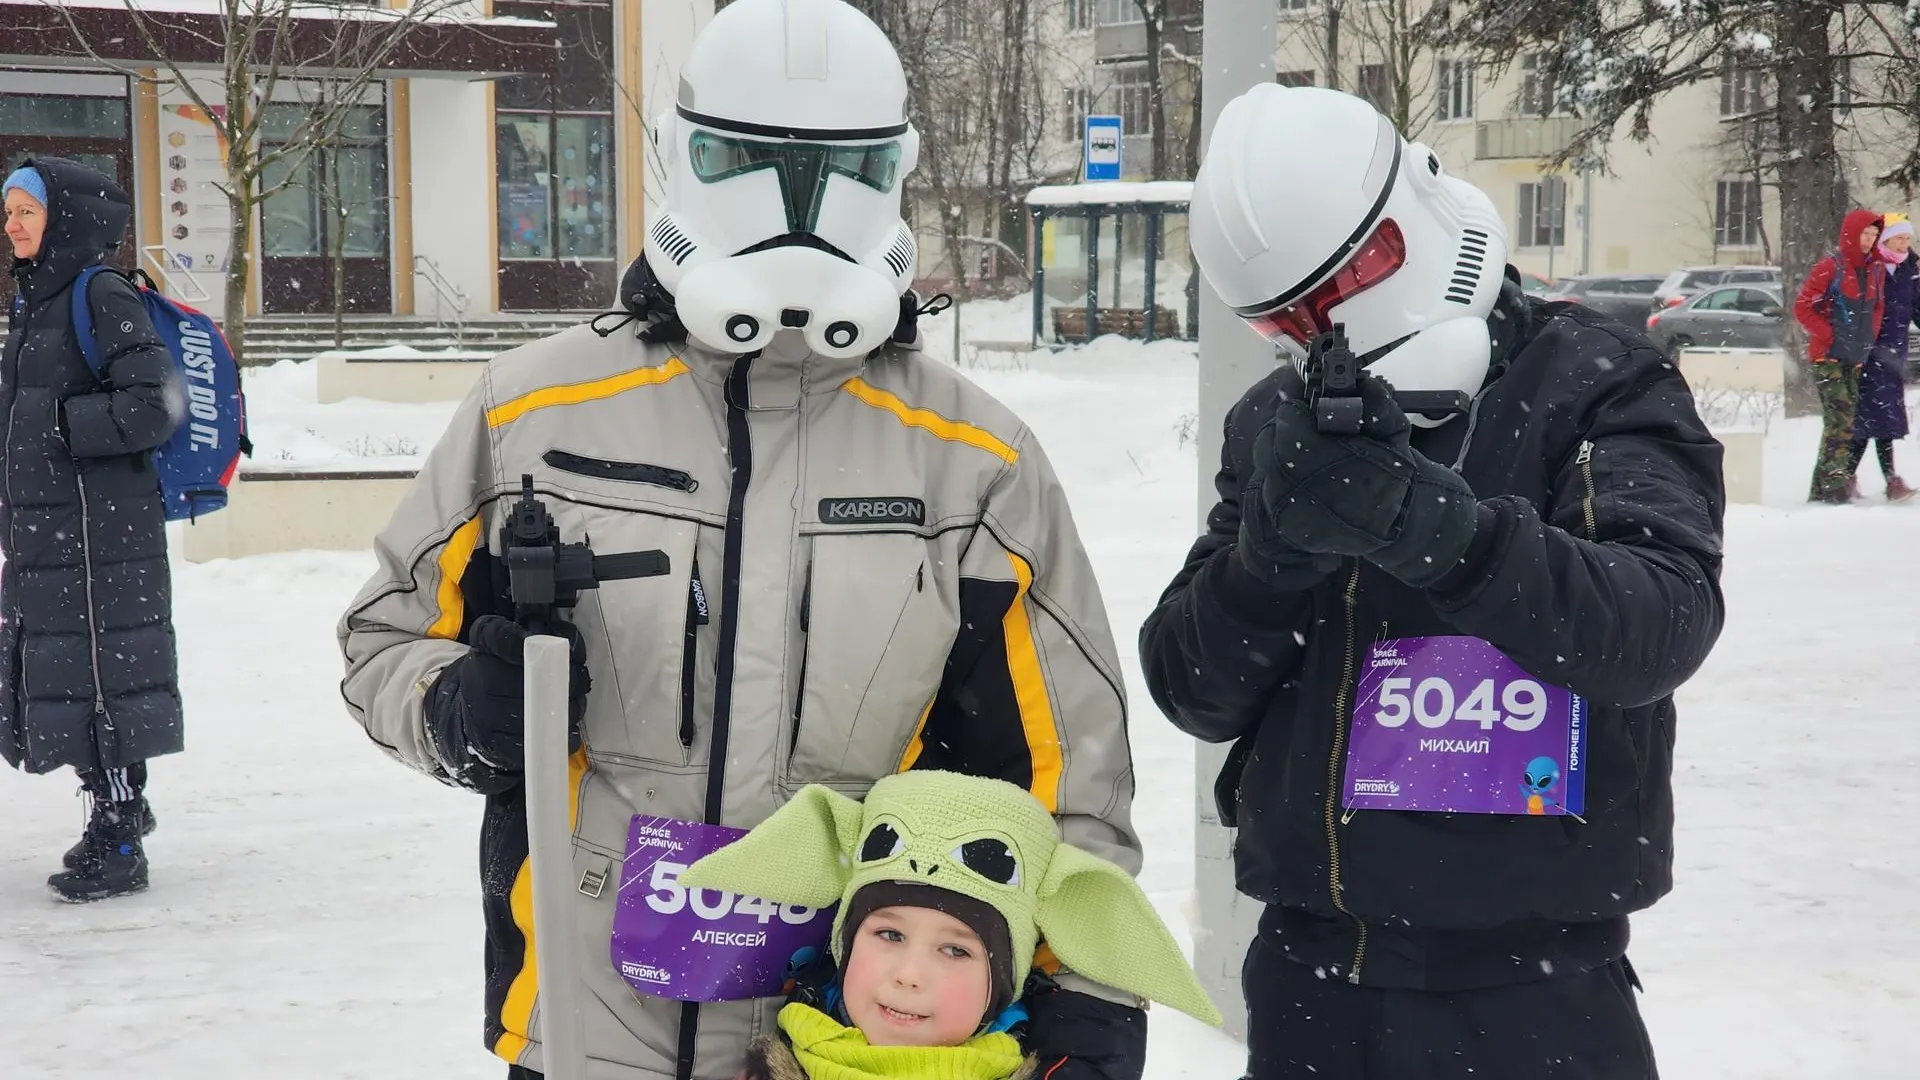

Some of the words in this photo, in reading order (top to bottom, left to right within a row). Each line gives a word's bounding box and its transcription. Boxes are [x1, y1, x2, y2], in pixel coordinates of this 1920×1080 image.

[178, 320, 216, 385] JUST
[188, 384, 218, 422] DO
[190, 422, 219, 452] IT.
[829, 501, 922, 519] KARBON
[692, 579, 708, 617] KARBON
[1371, 657, 1408, 668] CARNIVAL
[1373, 649, 1398, 659] SPACE
[1375, 677, 1547, 731] 5049
[1571, 693, 1581, 728] ПИТАН
[1420, 739, 1489, 754] МИХАИЛ
[1570, 728, 1580, 771] ГОРЯЧЕЕ
[638, 836, 684, 851] CARNIVAL
[640, 826, 671, 839] SPACE
[692, 929, 767, 947] АЛЕКСЕЙ
